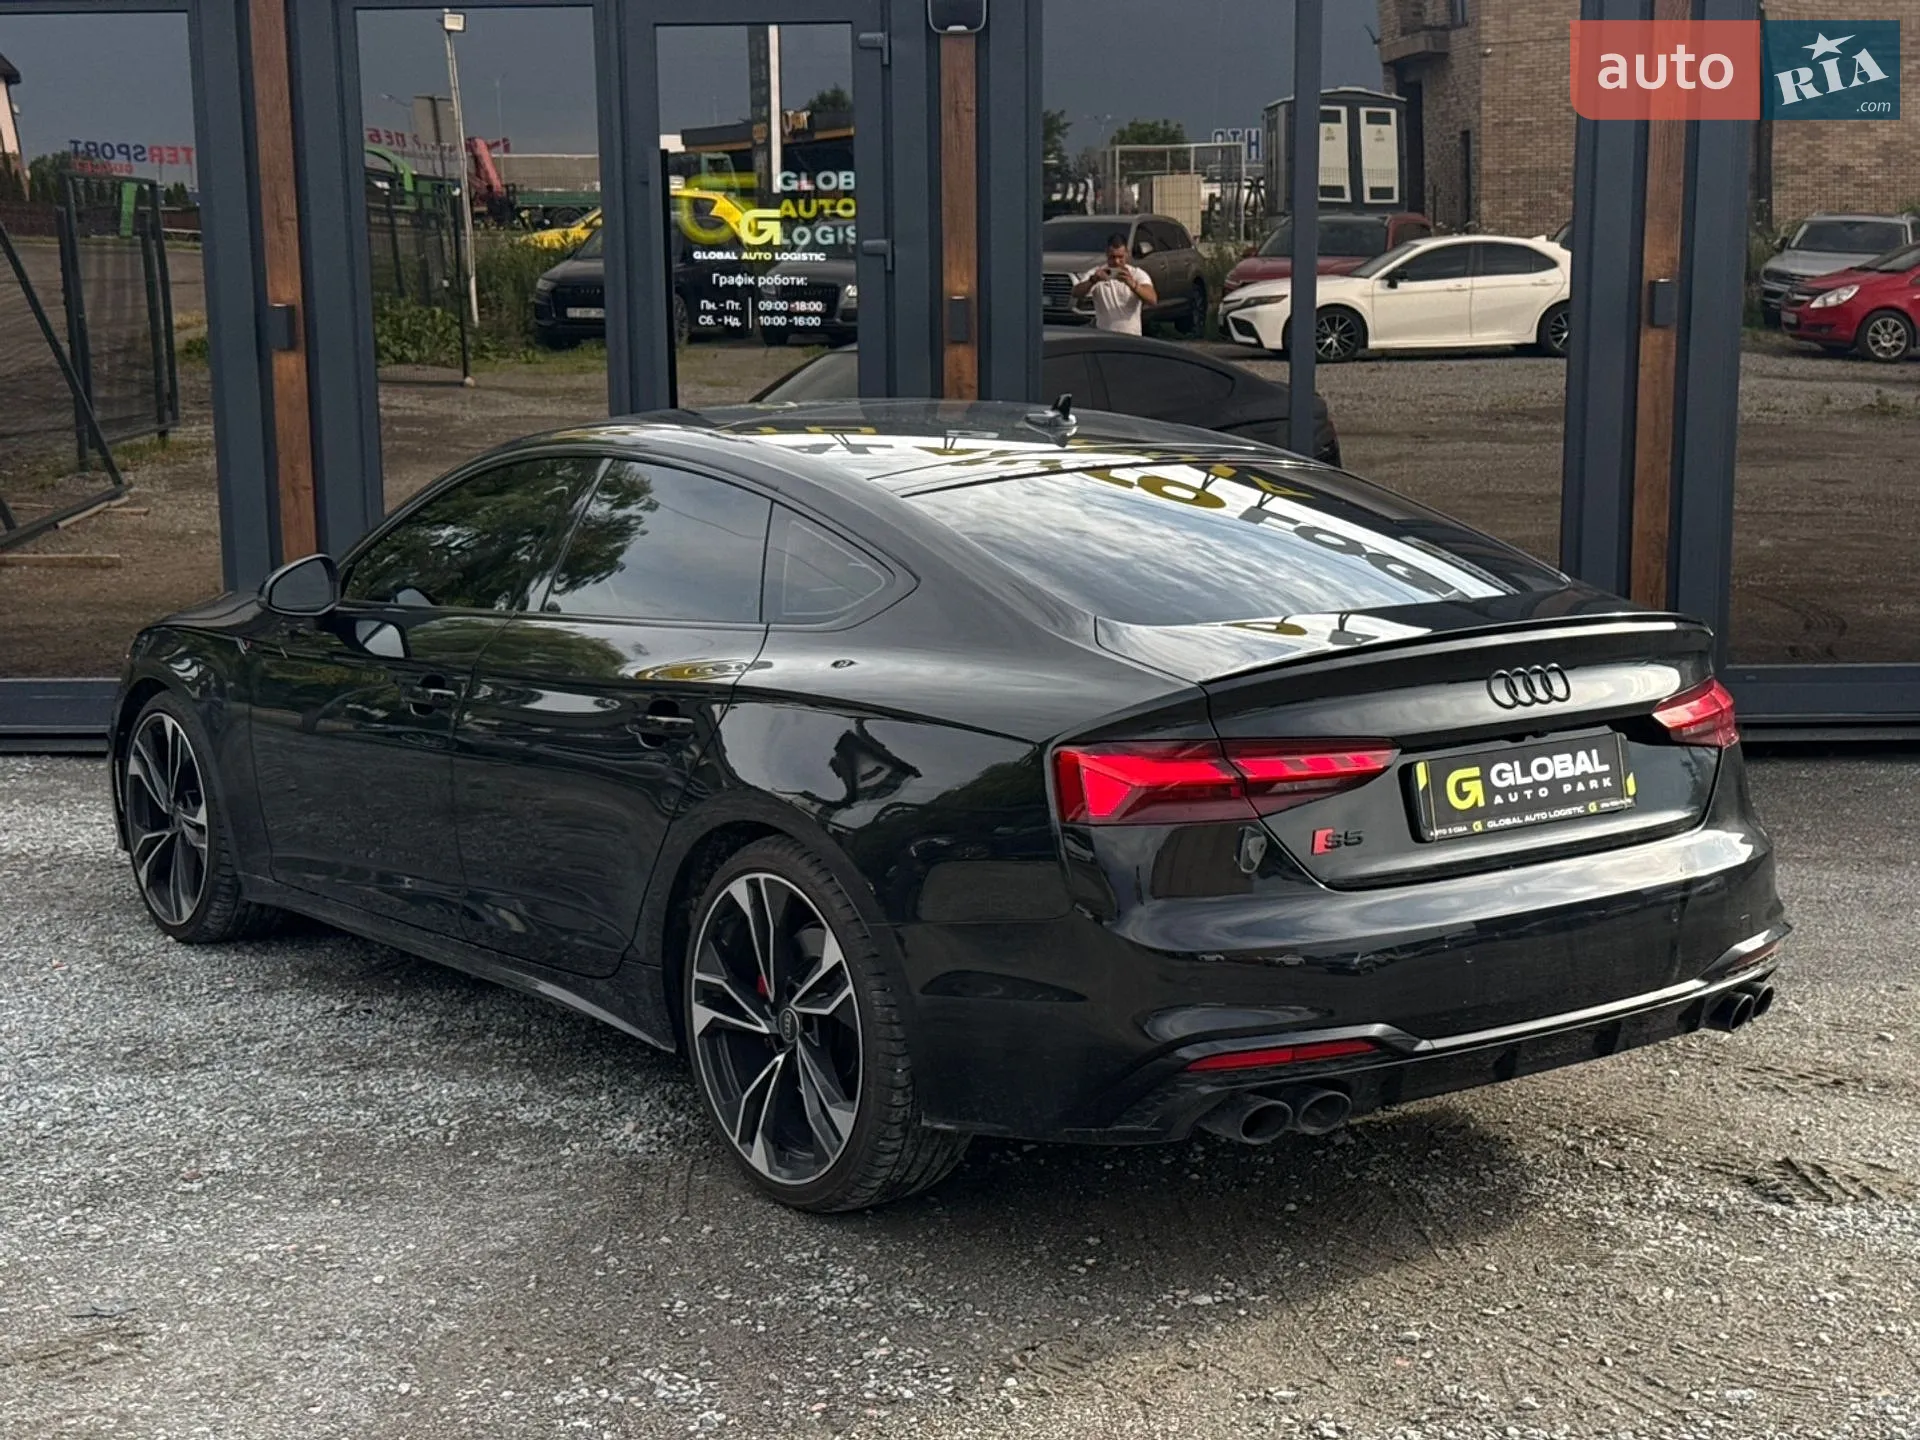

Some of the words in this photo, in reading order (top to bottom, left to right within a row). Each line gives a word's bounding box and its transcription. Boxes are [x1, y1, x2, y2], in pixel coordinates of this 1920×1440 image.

[780, 197, 857, 219] AUTO
[693, 251, 738, 260] GLOBAL
[741, 252, 772, 261] AUTO
[775, 252, 827, 261] LOGISTIC
[712, 273, 756, 288] Графік
[758, 274, 808, 288] роботи:
[1489, 749, 1610, 788] GLOBAL
[1493, 787, 1549, 805] AUTO
[1562, 776, 1613, 794] PARK
[1487, 816, 1524, 829] GLOBAL
[1524, 811, 1548, 824] AUTO
[1549, 804, 1586, 819] LOGISTIC
[1323, 829, 1365, 850] S5
